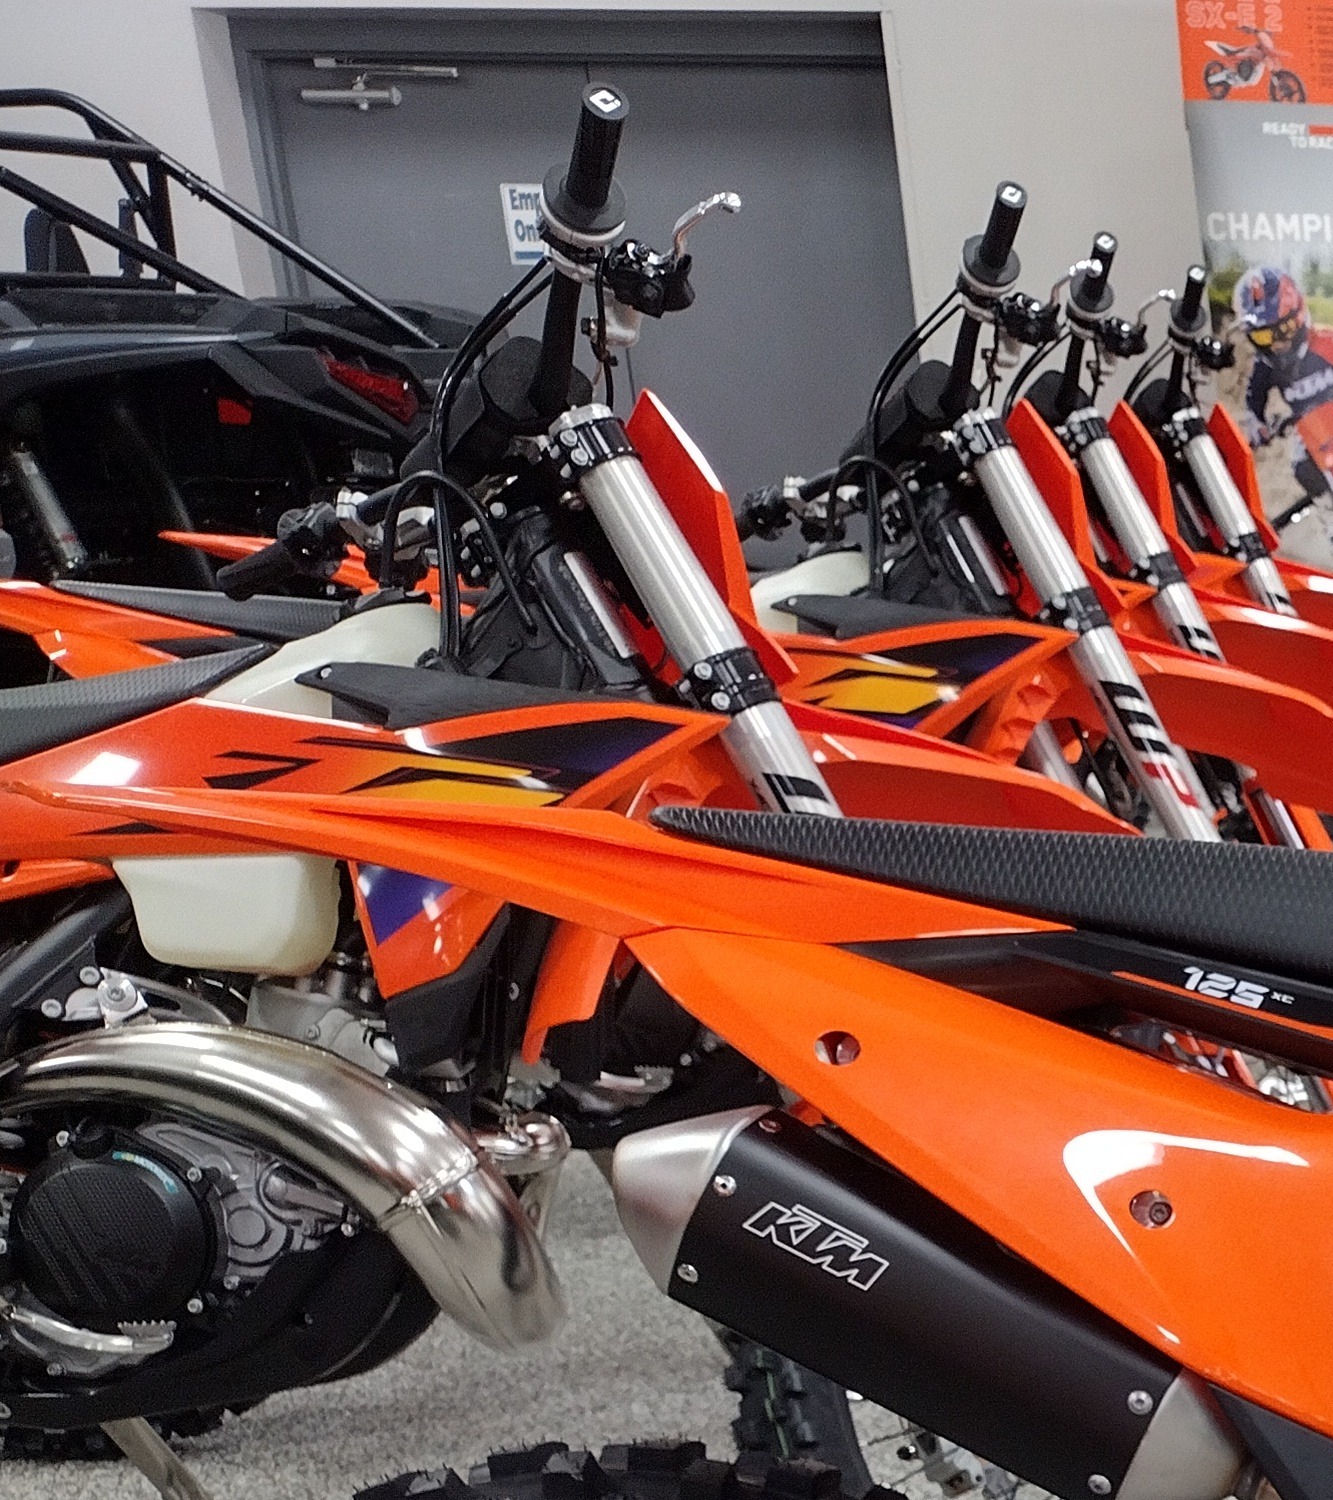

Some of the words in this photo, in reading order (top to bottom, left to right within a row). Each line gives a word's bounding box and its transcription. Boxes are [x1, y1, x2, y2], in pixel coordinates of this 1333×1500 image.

[1183, 966, 1270, 1009] 125
[1271, 991, 1295, 1005] XC
[742, 1201, 890, 1292] KTM
